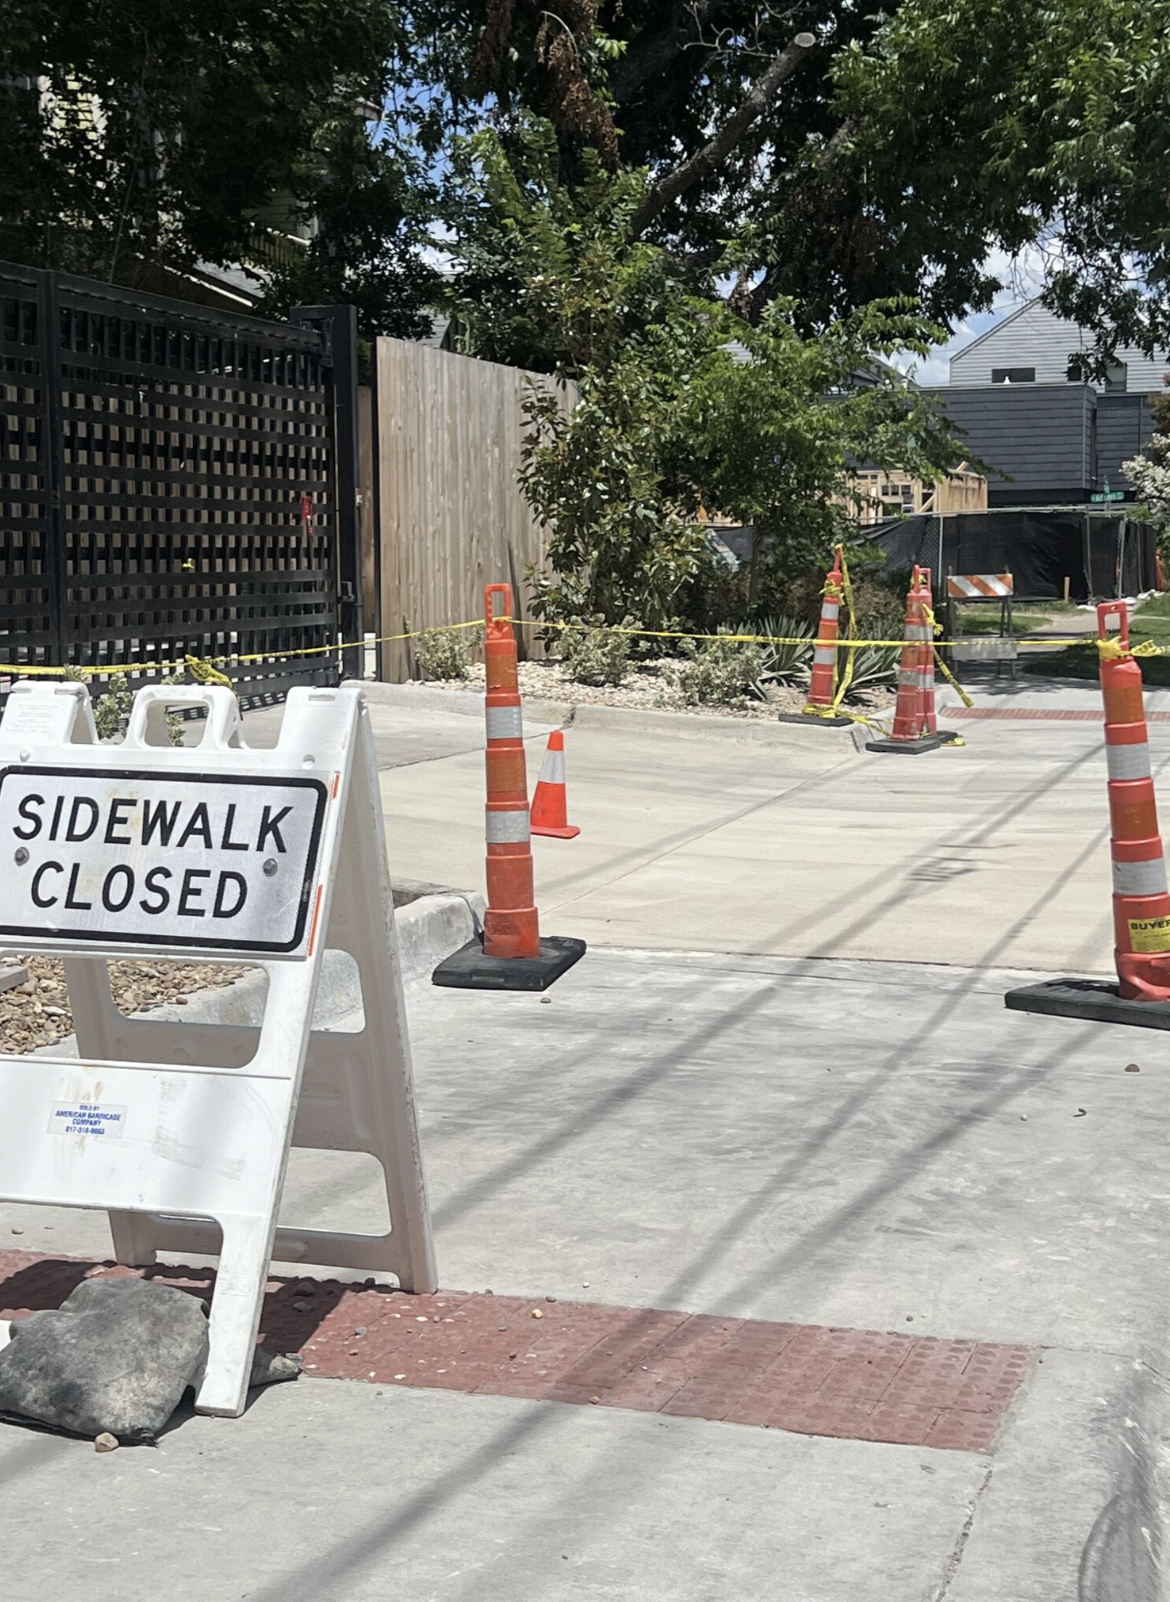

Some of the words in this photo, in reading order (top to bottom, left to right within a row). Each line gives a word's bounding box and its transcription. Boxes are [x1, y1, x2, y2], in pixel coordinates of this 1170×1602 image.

[13, 793, 294, 853] SIDEWALK
[31, 860, 247, 918] CLOSED
[55, 1110, 87, 1119] AMERICAN
[87, 1112, 121, 1121] BARRICADE
[72, 1118, 102, 1126] COMPANY
